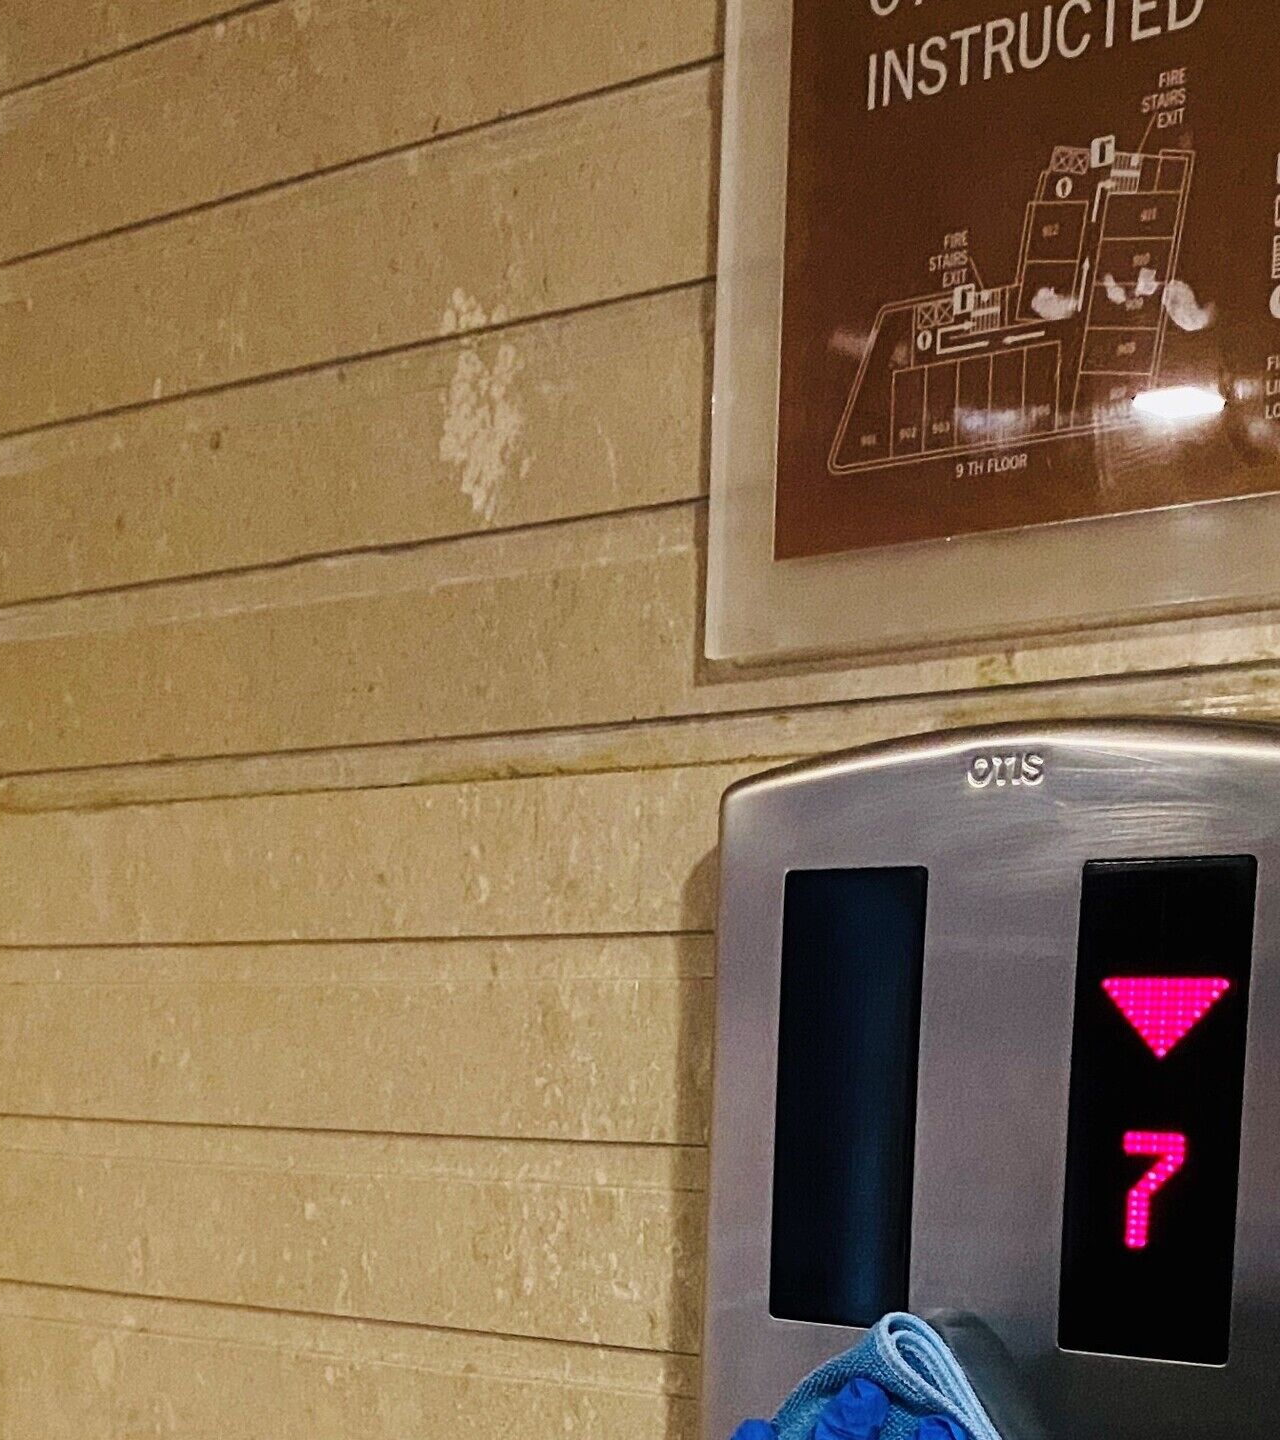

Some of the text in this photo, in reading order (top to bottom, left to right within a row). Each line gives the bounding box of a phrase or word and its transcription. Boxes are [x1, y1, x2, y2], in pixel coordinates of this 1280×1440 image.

[867, 0, 1204, 111] INSTRUCTED
[1158, 67, 1187, 88] FIRE
[1141, 88, 1187, 114] STAIRS
[1156, 107, 1187, 129] EXIT
[944, 230, 969, 250] FIRE
[928, 249, 969, 272] STAIRS
[942, 268, 968, 288] EXIT
[955, 453, 1029, 478] 9 TH FLOOR
[966, 751, 1045, 789] OTIS
[1123, 1130, 1187, 1249] 7
